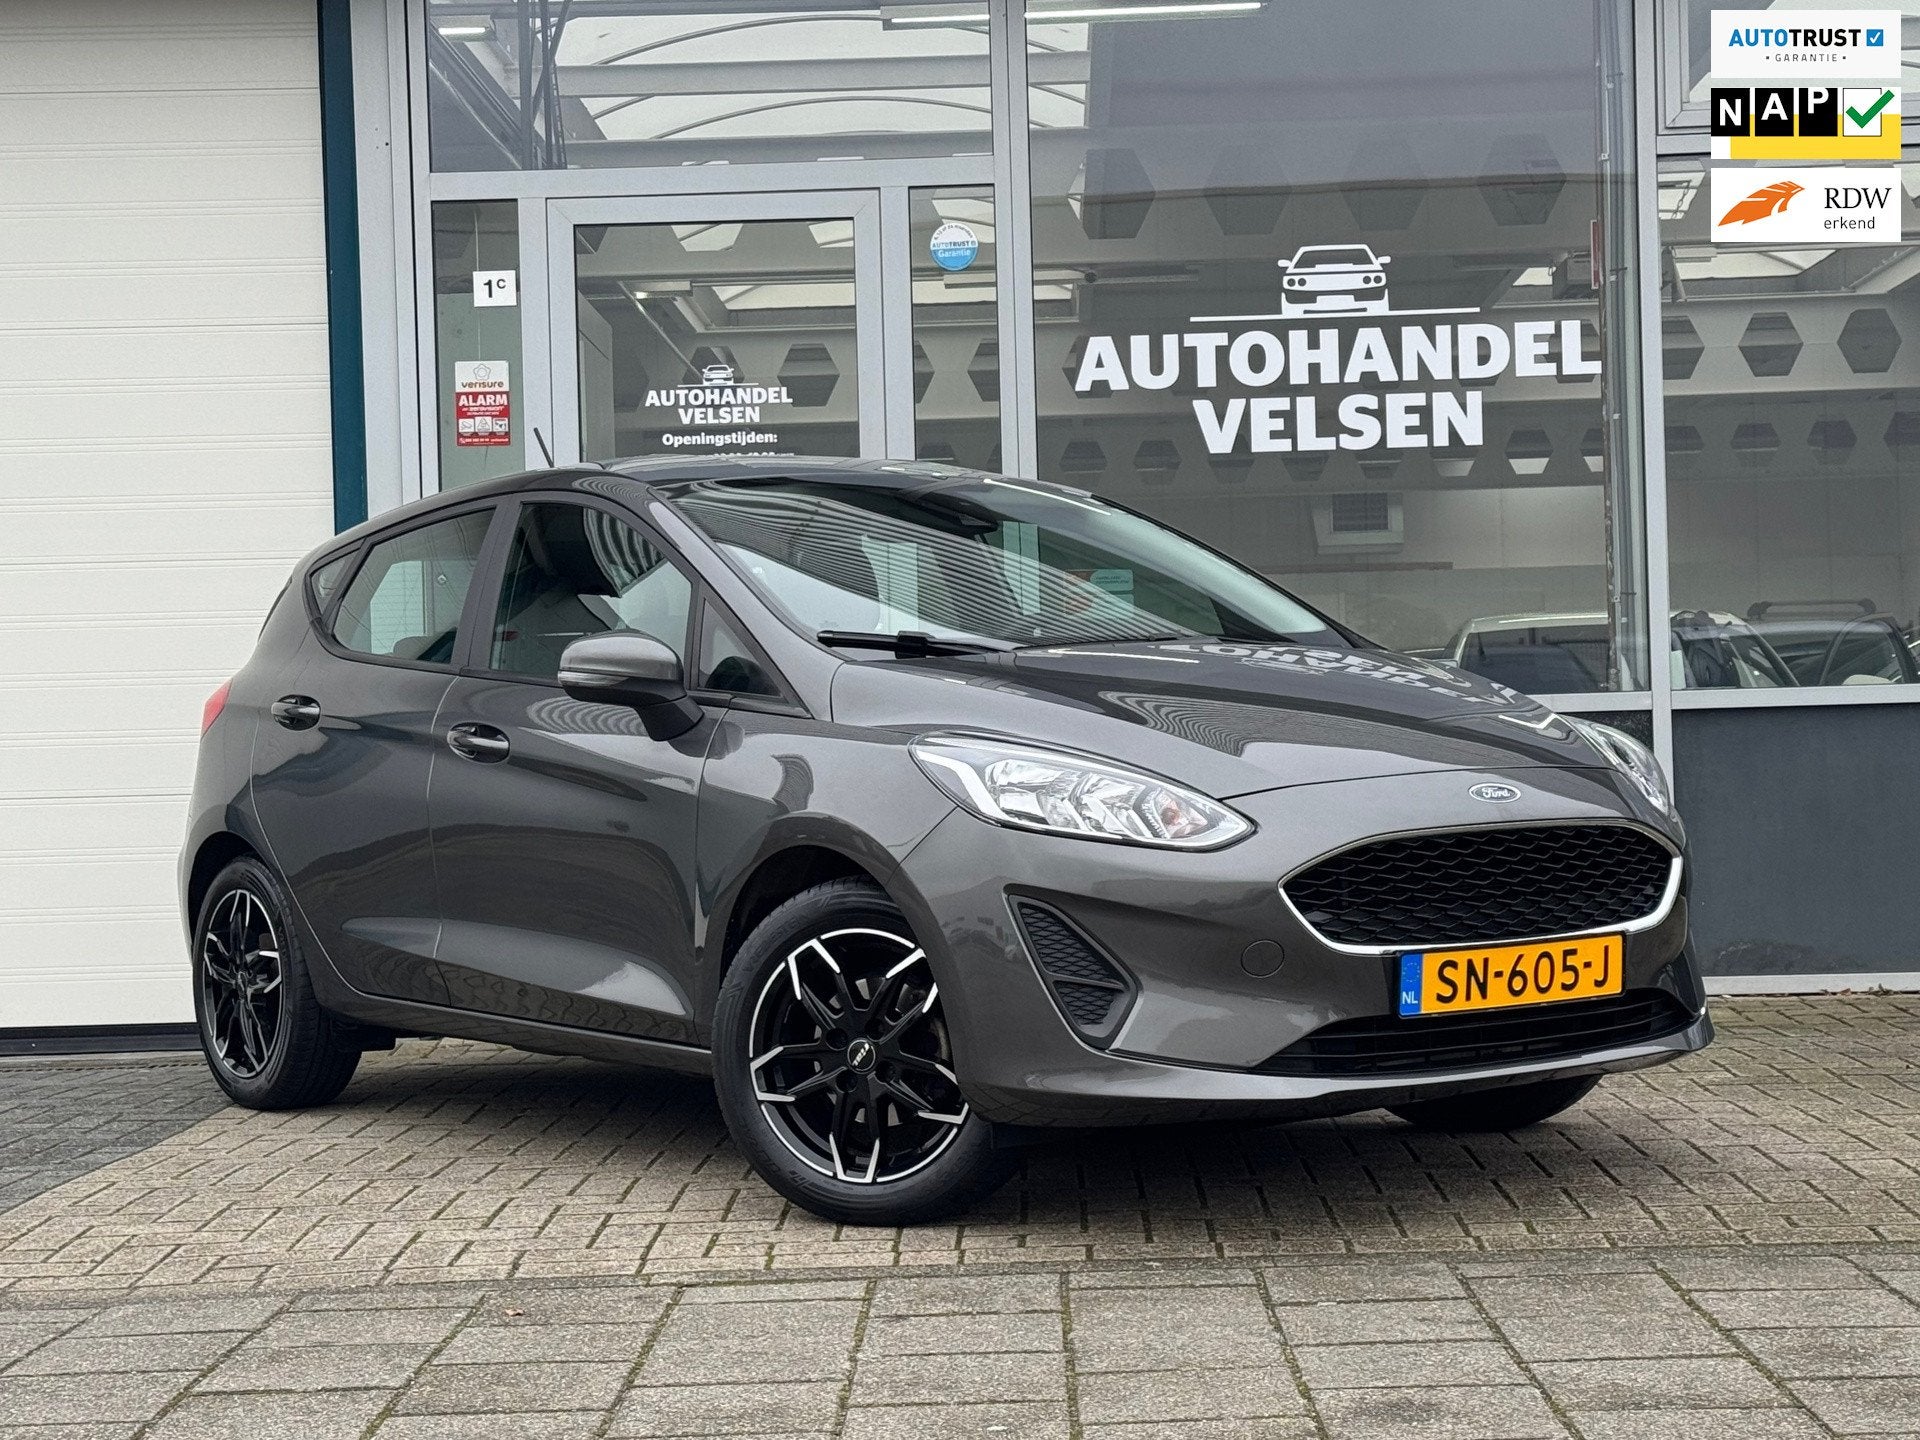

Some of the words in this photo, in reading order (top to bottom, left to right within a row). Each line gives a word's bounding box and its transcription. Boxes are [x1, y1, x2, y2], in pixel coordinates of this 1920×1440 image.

[1074, 319, 1602, 392] AUTOHANDEL
[461, 381, 504, 389] verisure
[459, 394, 508, 406] ALARM
[644, 386, 793, 407] AUTOHANDEL
[678, 406, 760, 425] VELSEN
[1192, 390, 1484, 454] VELSEN
[662, 431, 778, 448] Openingstijden:
[1482, 787, 1510, 798] Ford
[1436, 945, 1610, 1004] SN-605-J
[1402, 991, 1419, 1005] NL
